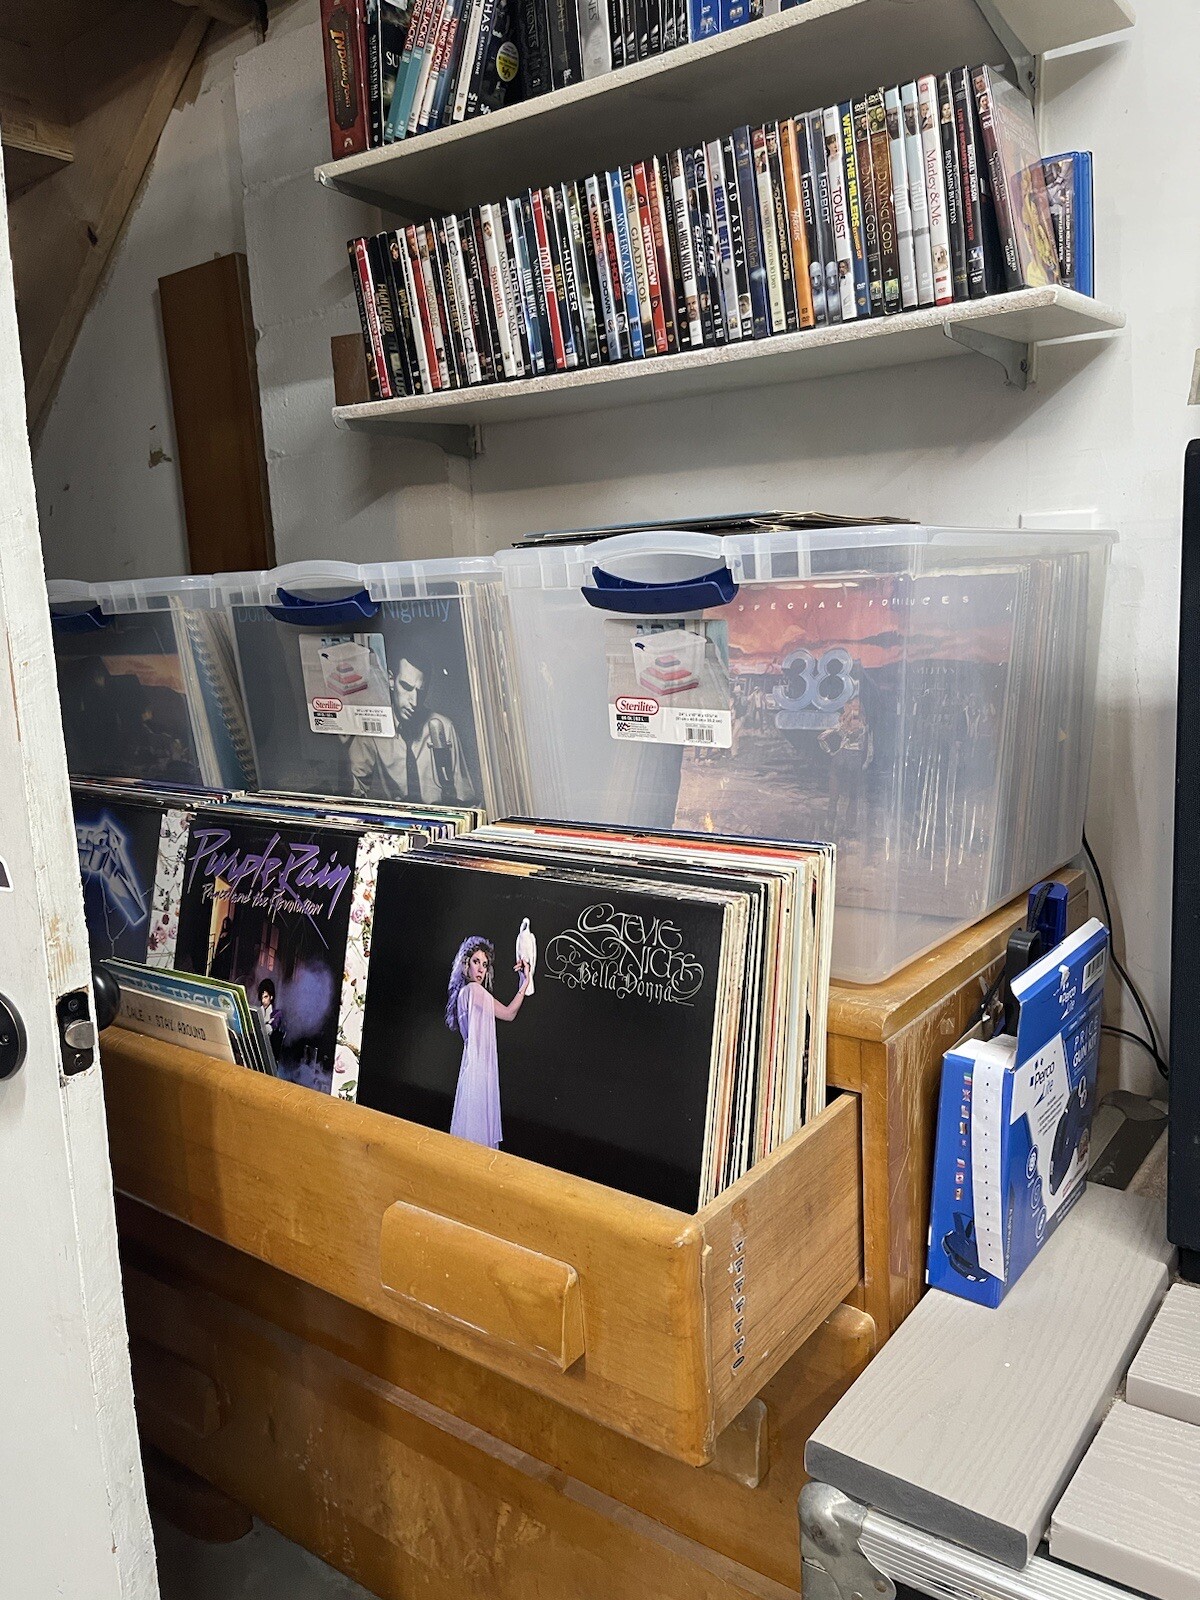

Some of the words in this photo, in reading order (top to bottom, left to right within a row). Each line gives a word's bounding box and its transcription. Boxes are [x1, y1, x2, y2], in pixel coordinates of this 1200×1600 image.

[438, 21, 449, 46] NURSE
[446, 17, 457, 44] NURSE
[329, 27, 353, 81] INDIANA
[340, 78, 353, 108] JONES
[956, 107, 964, 124] LIVE
[841, 115, 853, 154] WE'RE
[844, 155, 854, 179] THE
[923, 149, 940, 190] Marley
[943, 149, 955, 190] BENJAMIN
[964, 144, 975, 172] MICHAEL
[727, 180, 737, 201] AD
[799, 179, 813, 225] ROBOT
[816, 178, 831, 224] ROBOT
[929, 191, 940, 203] &
[967, 173, 978, 202] JACKSON
[646, 180, 663, 248] HANGOVER
[664, 195, 672, 221] ANGELS
[673, 198, 685, 218] HELL
[712, 186, 727, 222] HEAVY
[830, 186, 846, 240] TOURIST
[846, 180, 859, 227] MILLERS
[929, 204, 942, 226] Me
[946, 191, 958, 224] BUTTON
[962, 184, 974, 223] DANGEROUS
[571, 220, 580, 239] EDGE
[579, 186, 594, 257] SLEEPERS
[863, 215, 879, 247] CODE
[966, 224, 974, 241] TOUR
[466, 235, 475, 254] THE
[606, 232, 616, 260] SAFE
[677, 230, 689, 251] HIGH
[717, 225, 731, 262] METAL
[729, 213, 744, 267] ASTRA
[773, 197, 786, 252] LONESOME
[780, 253, 790, 280] DOVE
[880, 222, 894, 255] CODE
[470, 256, 479, 280] MIST
[531, 258, 539, 276] VAN
[539, 246, 550, 269] DON
[629, 226, 647, 305] GLADIATOR
[641, 224, 658, 286] INTERVIEW
[680, 251, 693, 282] WATER
[748, 252, 759, 268] Grail
[521, 267, 533, 292] JOHN
[552, 264, 563, 286] BLACK
[562, 249, 578, 311] HUNTER
[610, 262, 621, 300] HOUSE
[621, 258, 634, 296] ALASKA
[377, 282, 390, 309] FIGHT
[443, 262, 454, 301] TOWER
[450, 304, 460, 333] HEIST
[489, 264, 504, 319] Spanglish
[498, 250, 513, 310] MONSTER'S
[508, 314, 518, 339] BALL
[507, 257, 525, 335] ROBOCOP
[525, 294, 537, 319] WICK
[534, 277, 546, 316] HELSING
[556, 287, 565, 301] SEA
[382, 308, 395, 332] CLUB
[382, 594, 450, 623] Nightfly
[738, 602, 842, 612] SPECIAL
[772, 648, 859, 712] 38
[316, 700, 340, 710] Sterilite
[620, 700, 656, 712] Sterilite
[187, 828, 282, 894] Purple
[279, 842, 351, 921] Rain
[233, 890, 252, 906] and
[578, 902, 682, 950] STEVIE
[616, 963, 676, 1004] Donna
[156, 1014, 174, 1032] STAY
[178, 1020, 206, 1041] AROUND
[1074, 1015, 1099, 1052] PRICE
[1073, 1045, 1088, 1068] GUN
[1088, 1032, 1098, 1056] KIT
[1034, 1061, 1056, 1089] Perco
